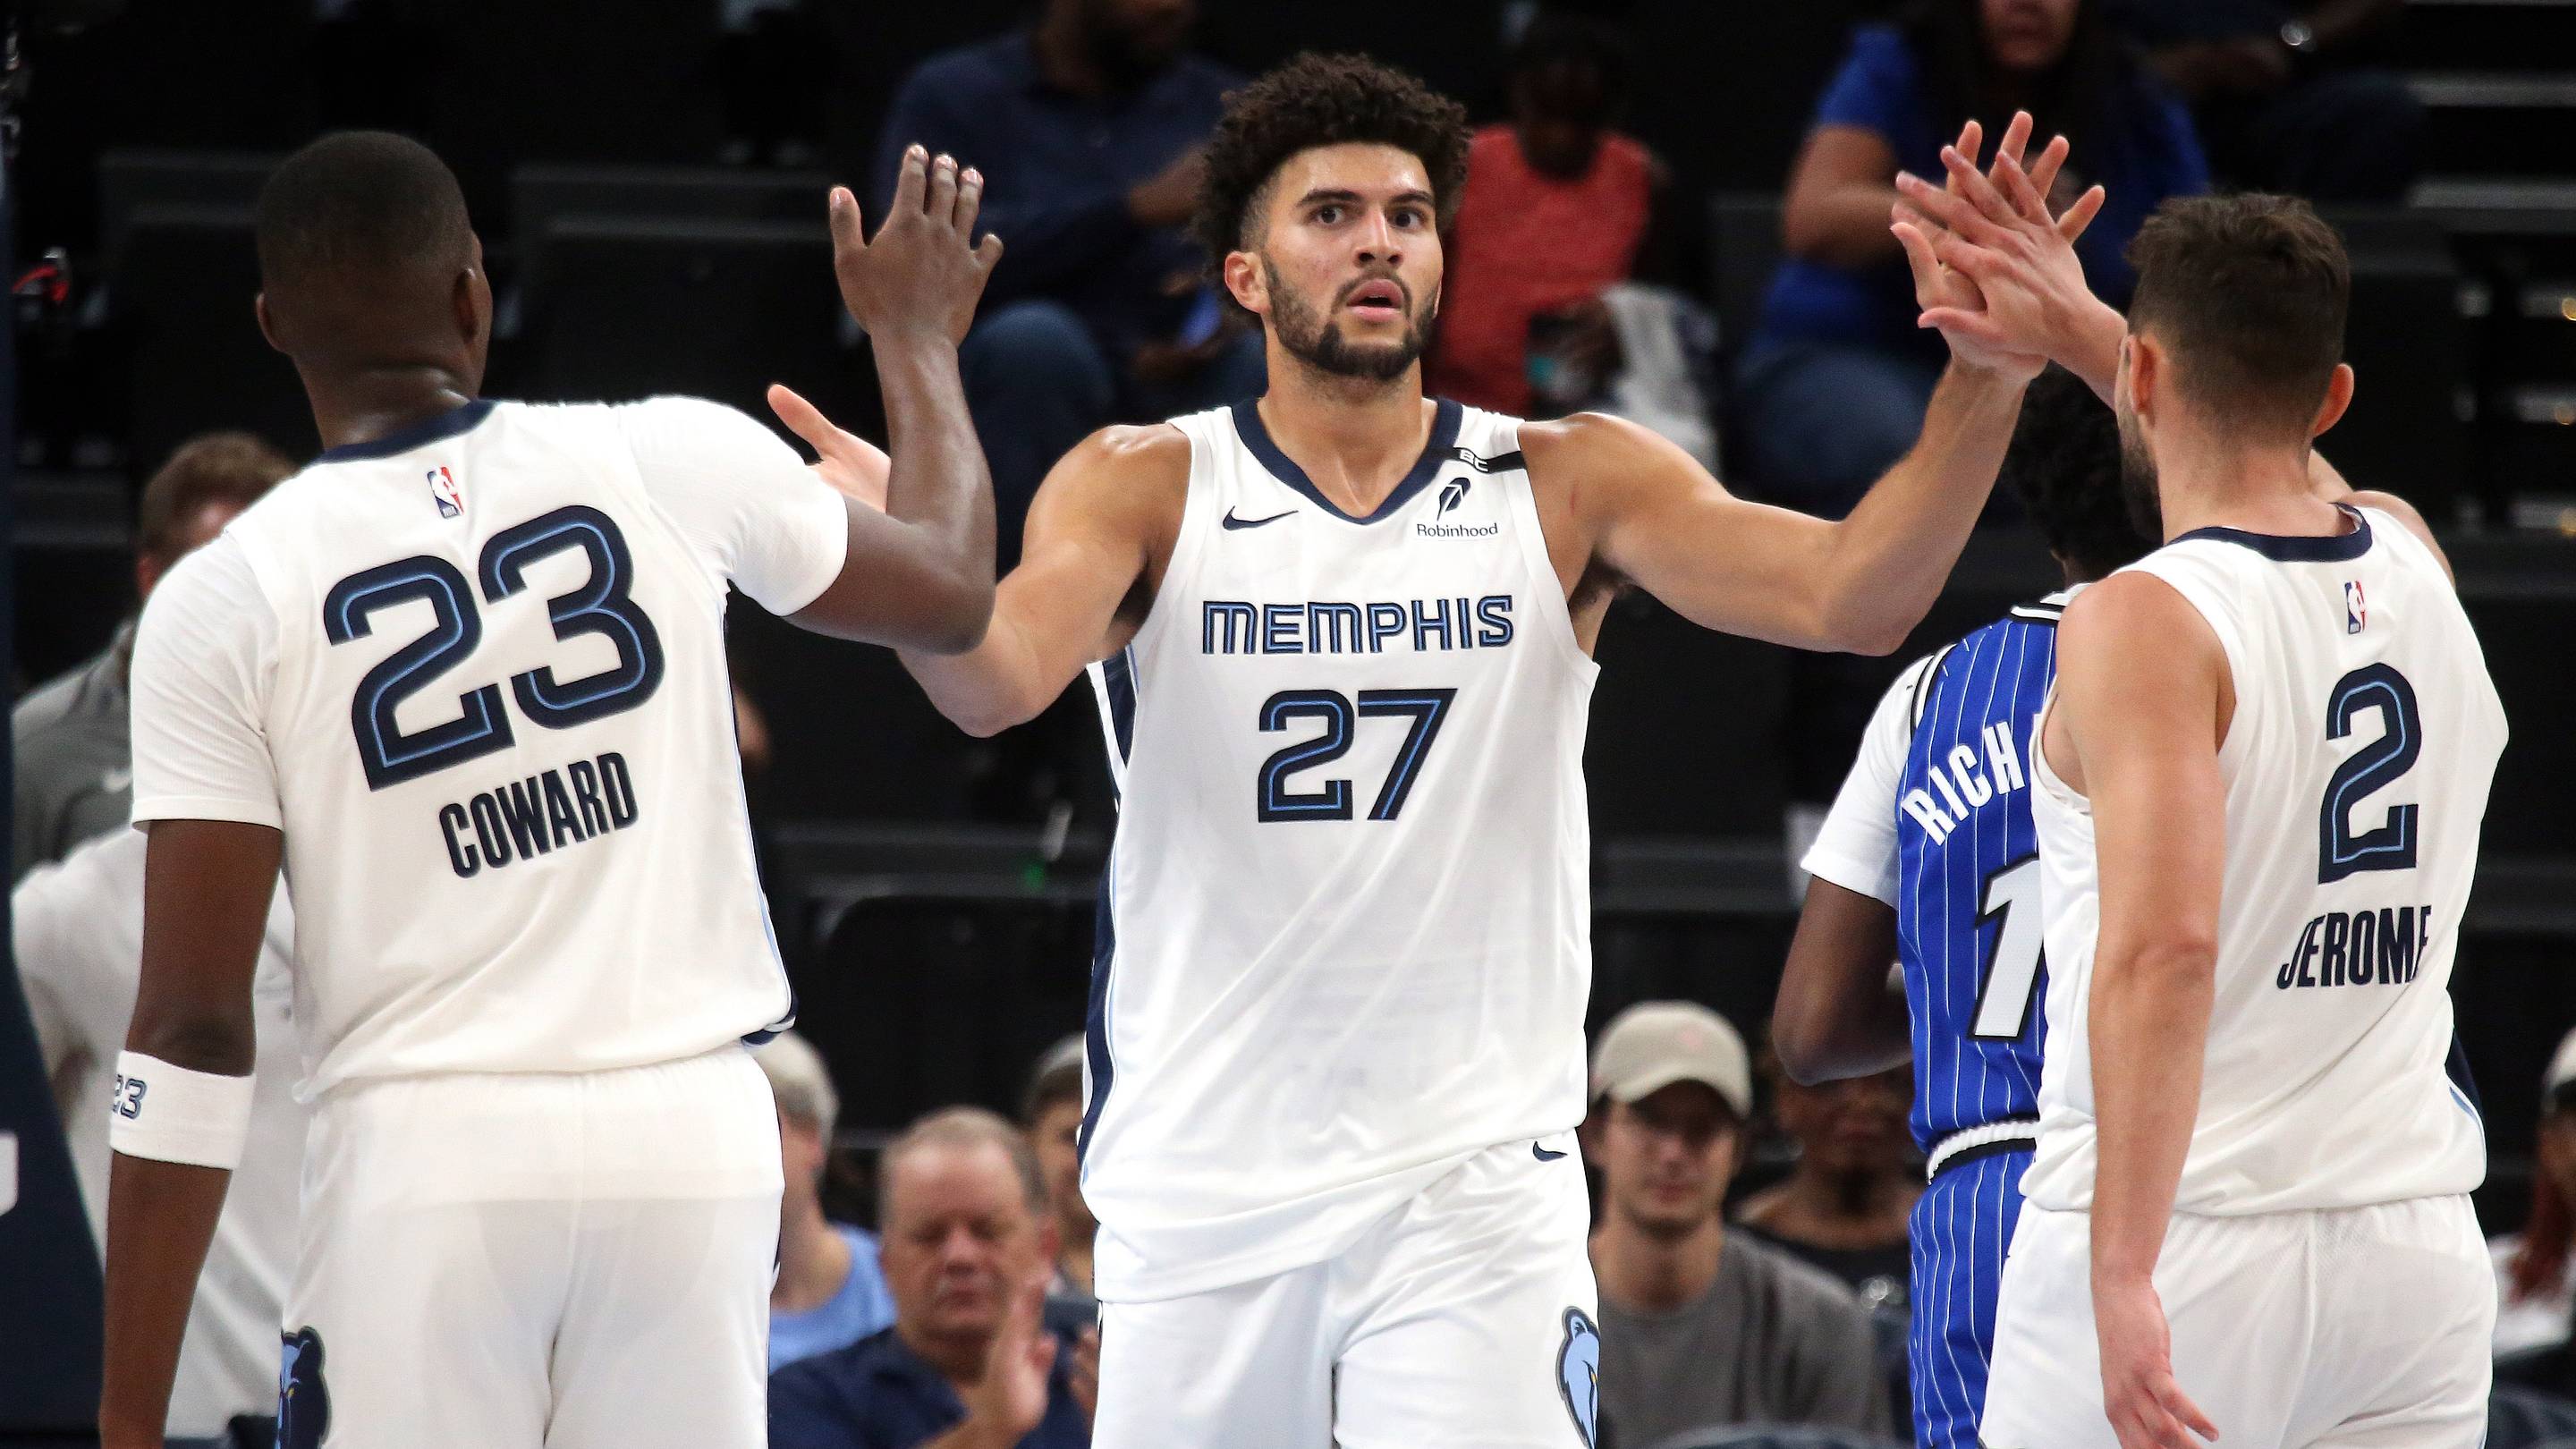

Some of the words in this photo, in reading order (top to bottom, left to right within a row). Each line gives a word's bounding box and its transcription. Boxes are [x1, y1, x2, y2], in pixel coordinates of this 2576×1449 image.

[1417, 522, 1498, 537] Robinhood
[324, 505, 665, 791] 23
[1203, 594, 1514, 655] MEMPHIS
[438, 750, 639, 878] COWARD
[1258, 688, 1458, 824] 27
[1900, 719, 2029, 846] RICH
[2318, 663, 2423, 885] 2
